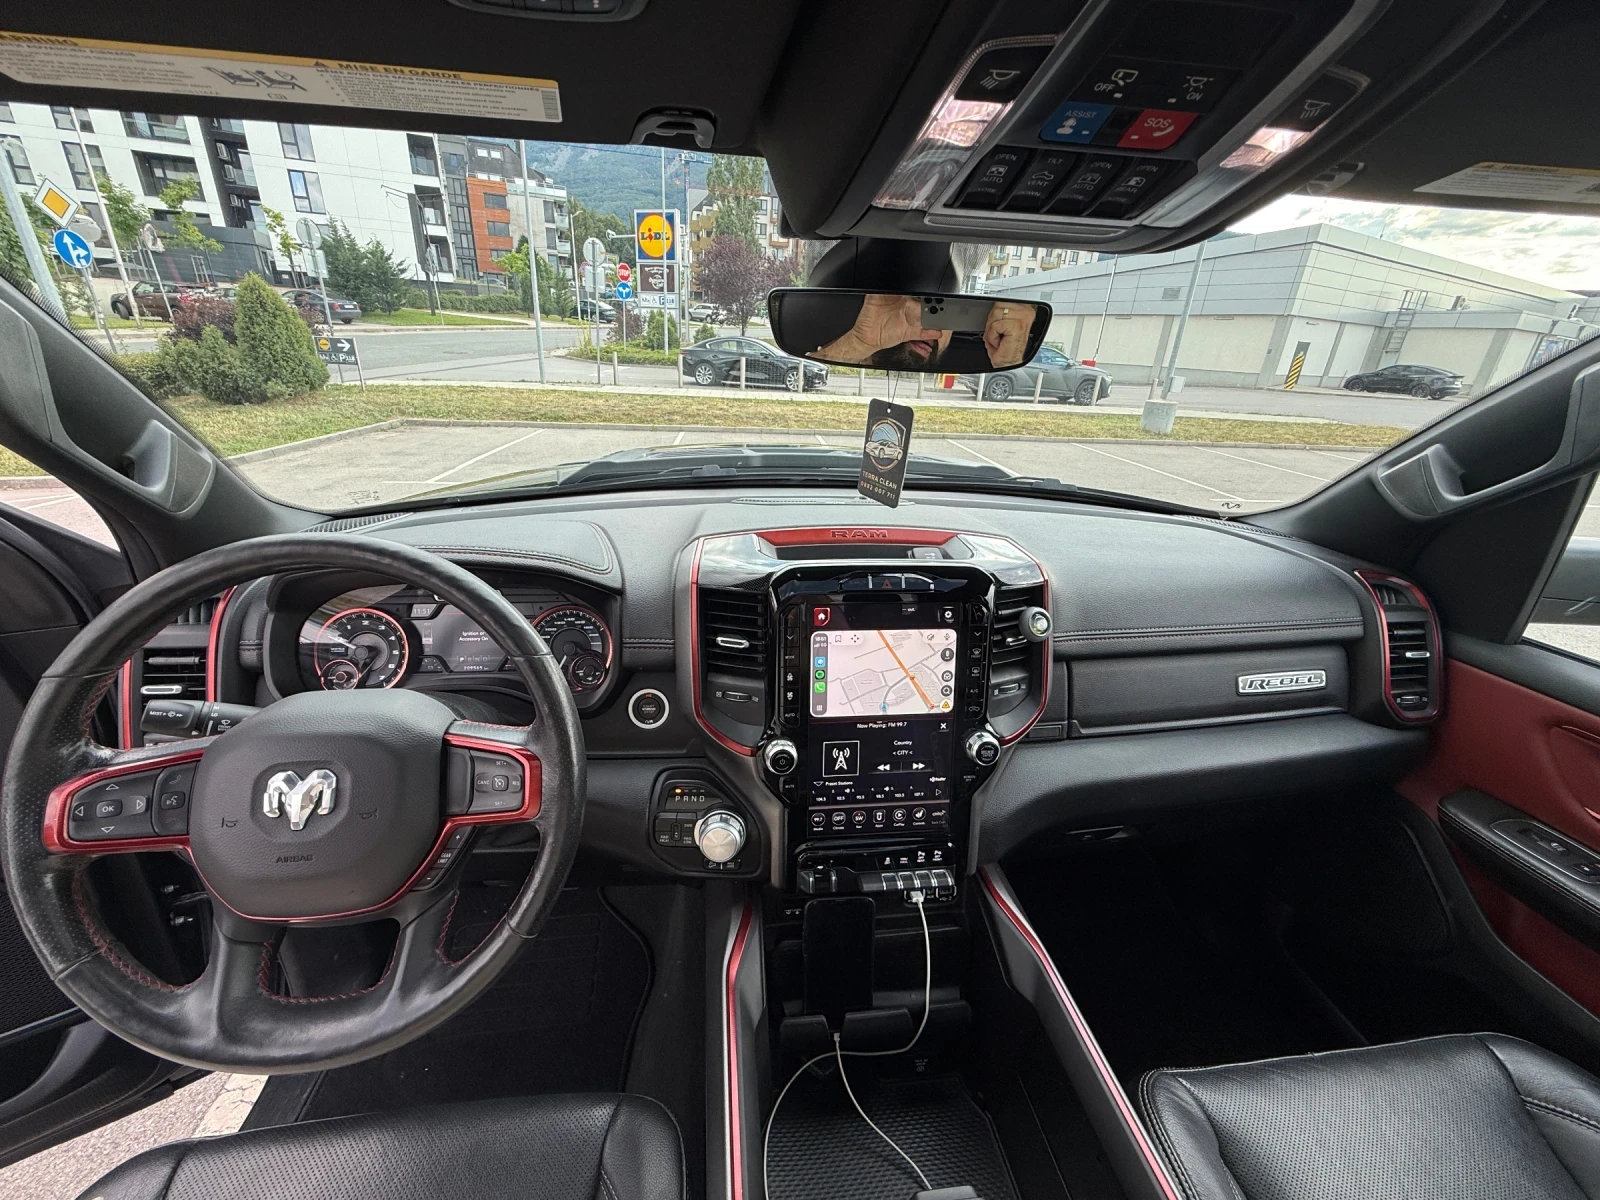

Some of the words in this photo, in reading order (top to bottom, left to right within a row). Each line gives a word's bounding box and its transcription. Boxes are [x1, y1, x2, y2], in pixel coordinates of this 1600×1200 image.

[338, 63, 378, 72] MISE
[383, 66, 404, 75] EN
[409, 69, 462, 79] GARDE
[1094, 82, 1114, 93] OFF
[1187, 91, 1202, 101] ON
[1064, 110, 1096, 119] ASSIST
[1144, 117, 1171, 128] SOS
[995, 153, 1017, 161] OPEN
[1090, 162, 1112, 170] OPEN
[981, 176, 1004, 184] AUTO
[1028, 180, 1049, 188] VENT
[1072, 183, 1094, 191] AUTO
[862, 471, 878, 482] TERRA
[880, 478, 897, 490] CLEAN
[830, 529, 888, 538] RAM
[1246, 675, 1320, 690] REBEL
[276, 854, 313, 864] AIRBAG
